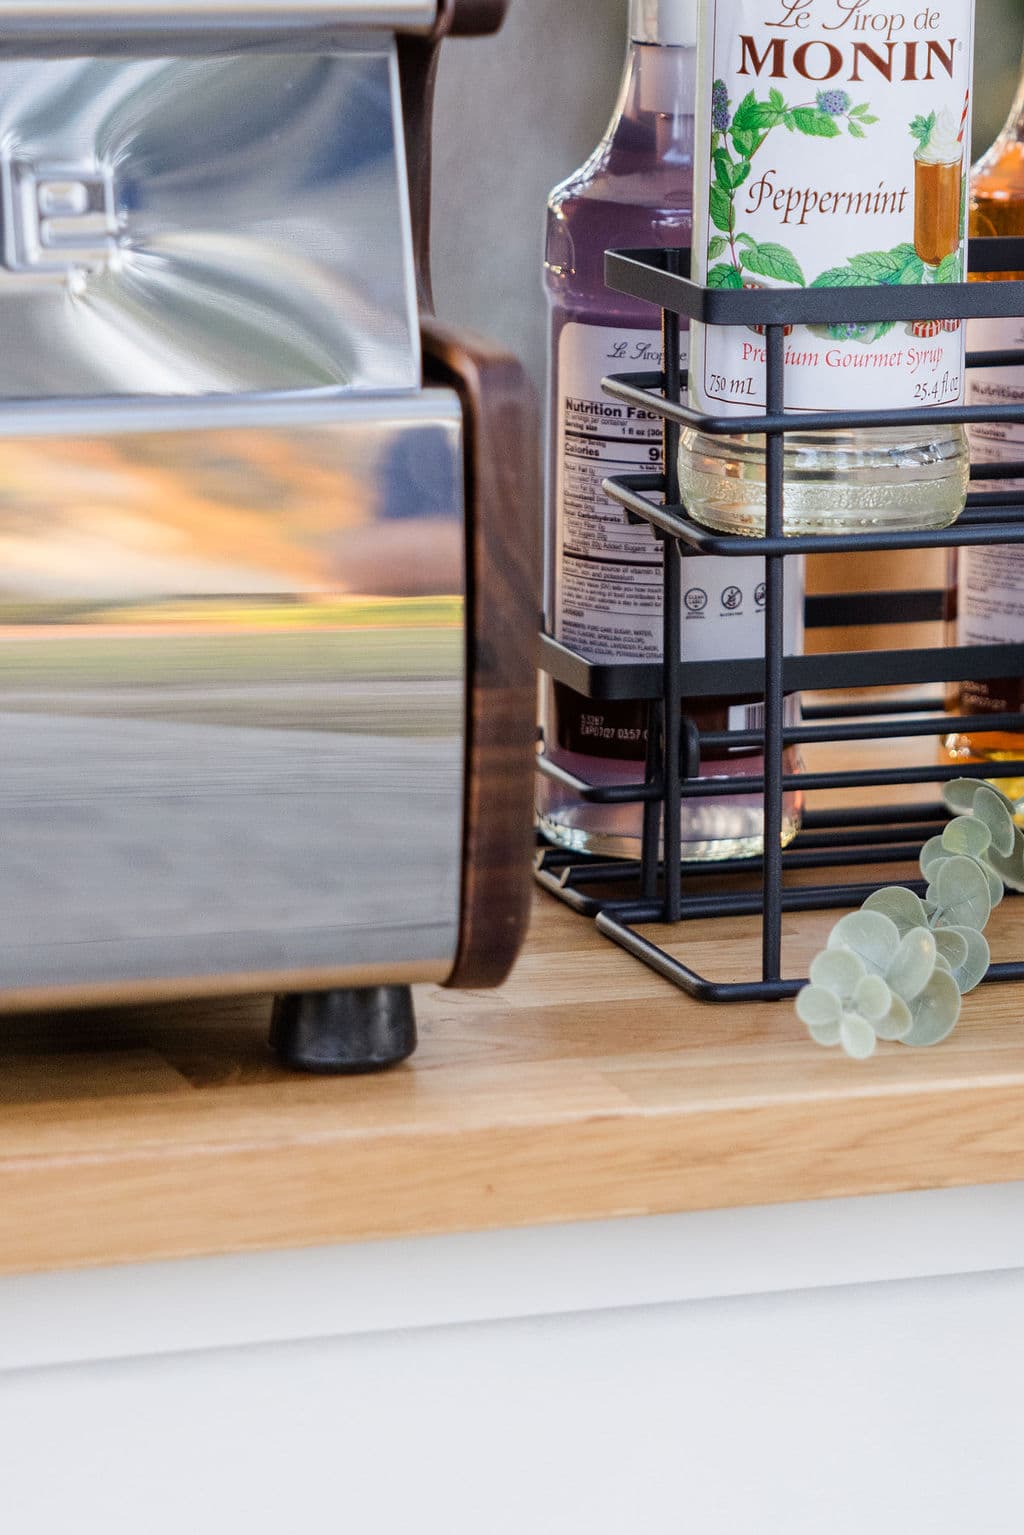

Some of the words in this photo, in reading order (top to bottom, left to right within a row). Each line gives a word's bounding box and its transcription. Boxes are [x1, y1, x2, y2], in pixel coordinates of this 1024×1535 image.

[913, 7, 940, 30] de
[736, 34, 957, 83] MONIN
[745, 169, 910, 225] Peppermint
[606, 342, 628, 359] Le
[742, 342, 819, 368] Preium
[825, 348, 903, 369] Gourmet
[906, 346, 944, 374] Syrup
[709, 373, 727, 392] 750
[730, 376, 757, 395] mL
[913, 381, 938, 401] 25.4
[565, 399, 622, 418] Nutrition
[565, 443, 599, 456] Calories
